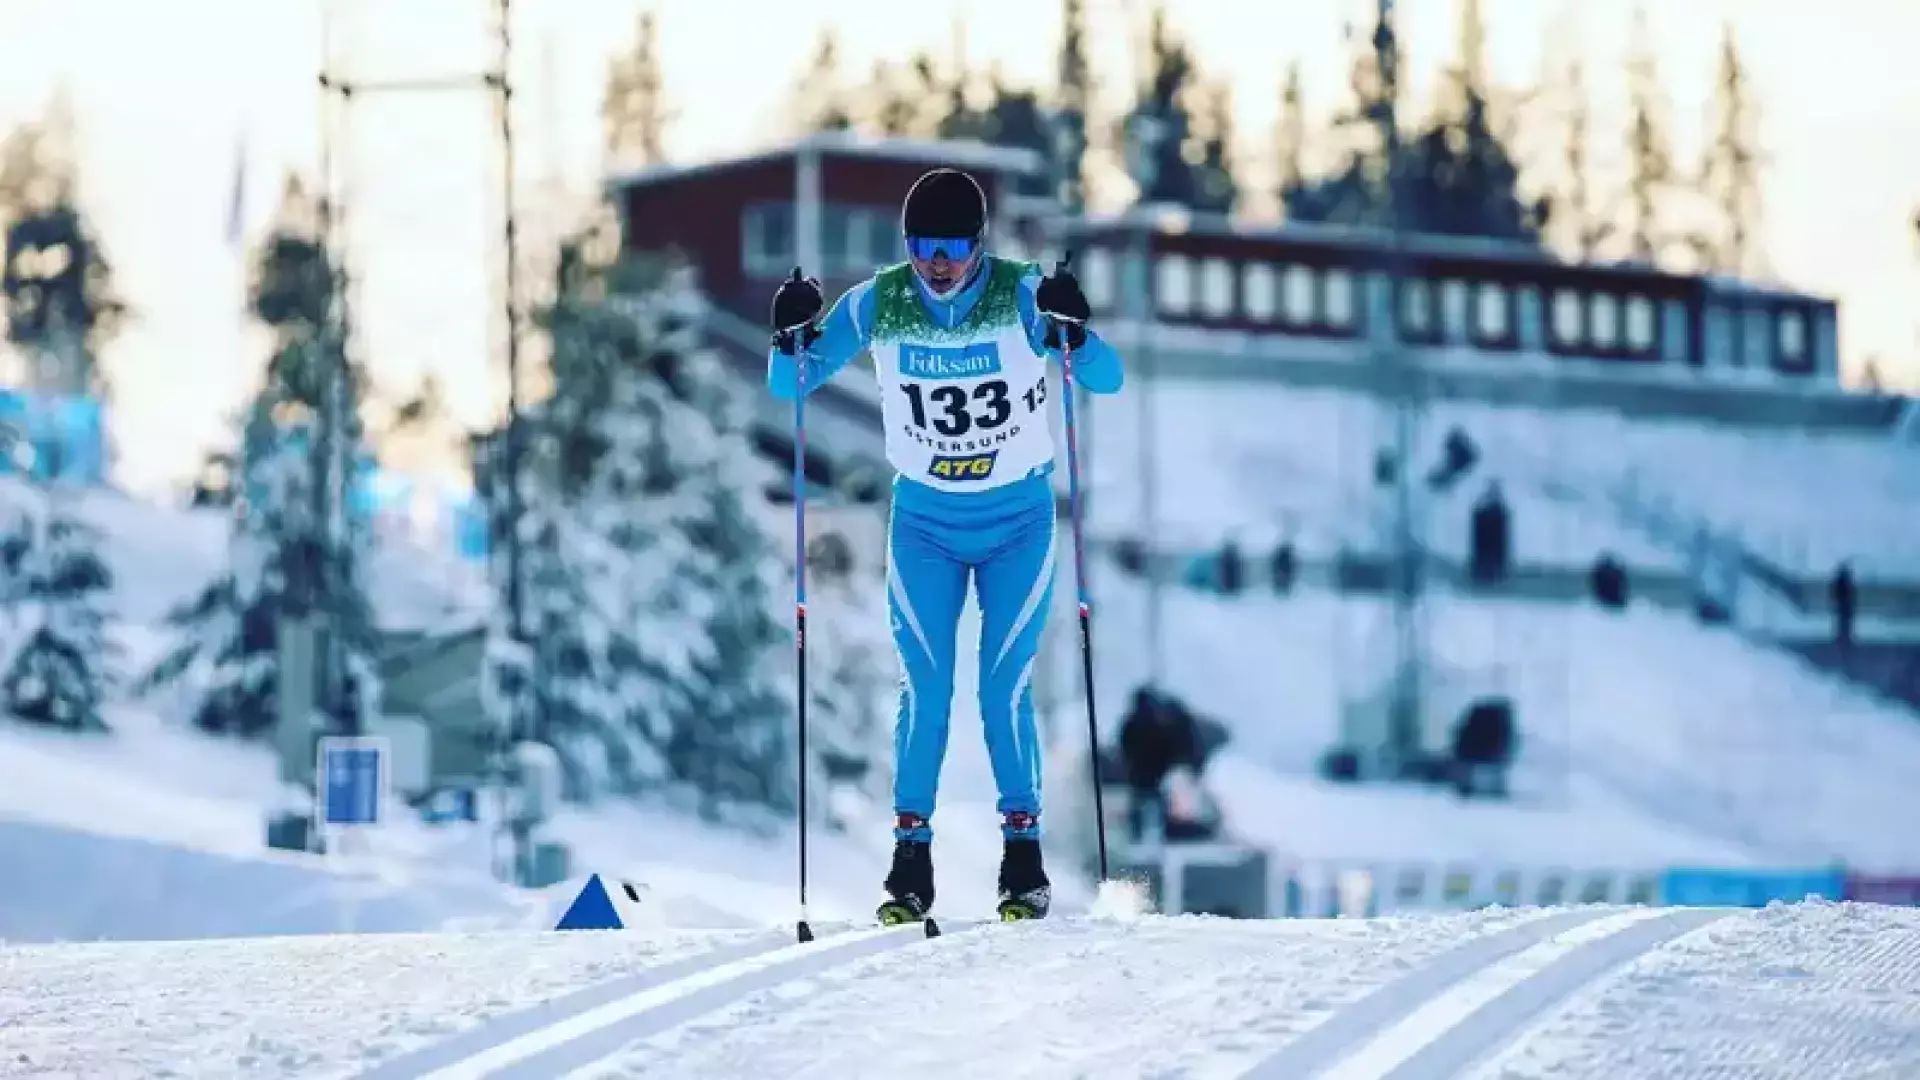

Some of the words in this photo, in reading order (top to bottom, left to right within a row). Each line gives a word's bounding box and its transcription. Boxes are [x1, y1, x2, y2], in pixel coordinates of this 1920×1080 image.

[909, 351, 991, 373] Folksam
[900, 380, 1011, 436] 133
[934, 458, 992, 476] ATG
